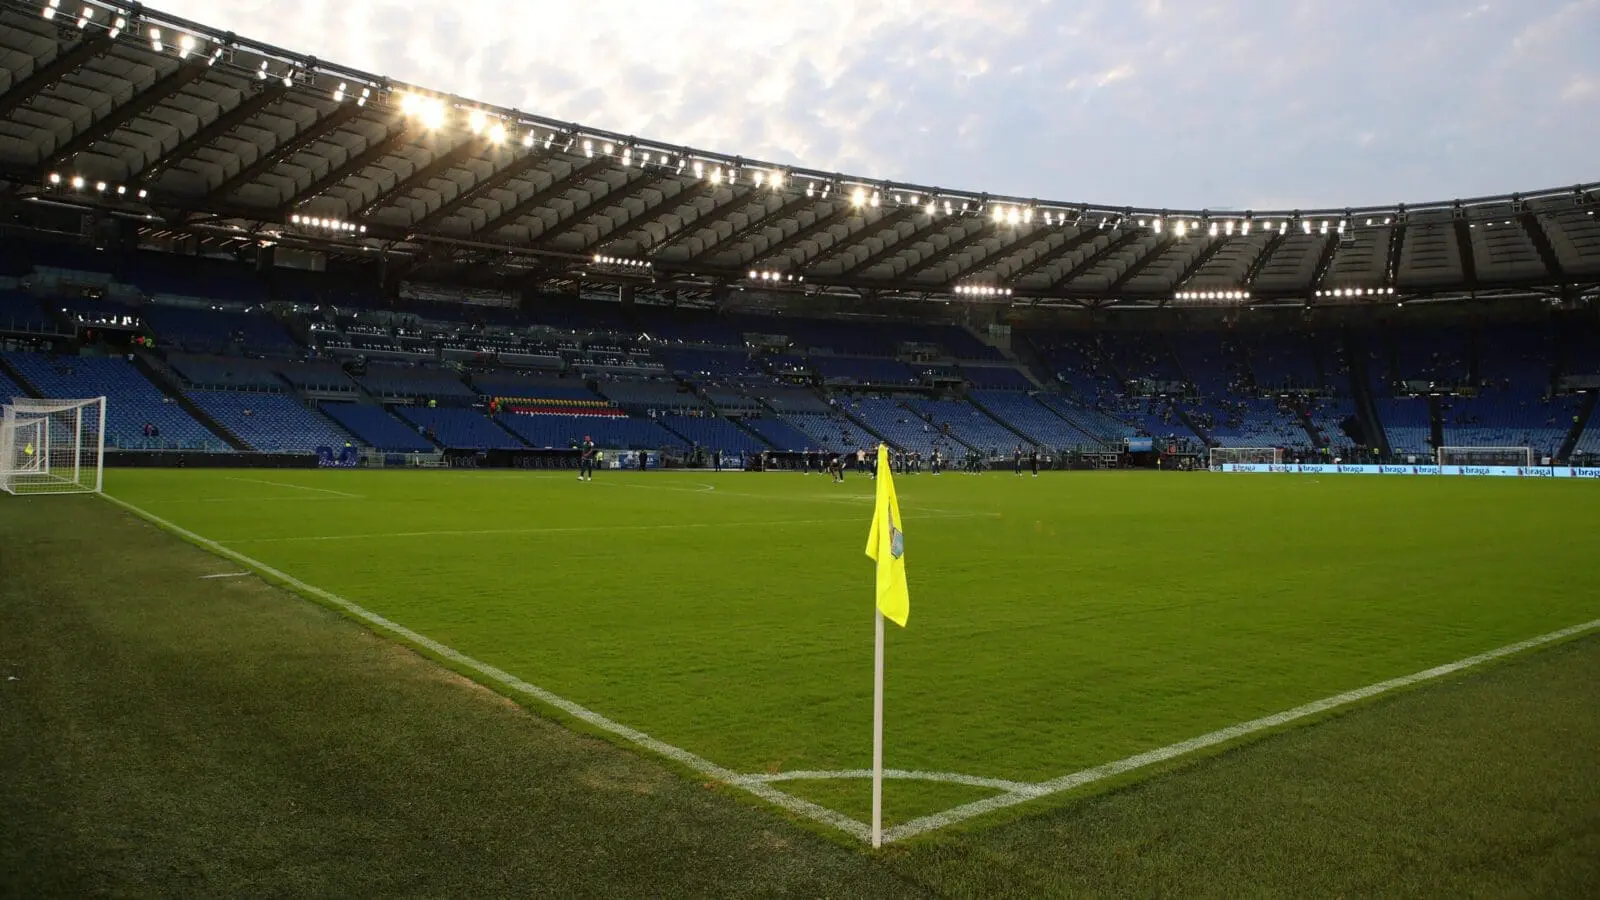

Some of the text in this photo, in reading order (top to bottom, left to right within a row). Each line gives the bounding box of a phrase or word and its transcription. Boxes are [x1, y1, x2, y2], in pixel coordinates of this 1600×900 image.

[1343, 465, 1364, 474] braga
[1384, 466, 1407, 474] braga
[1465, 466, 1490, 475] braga
